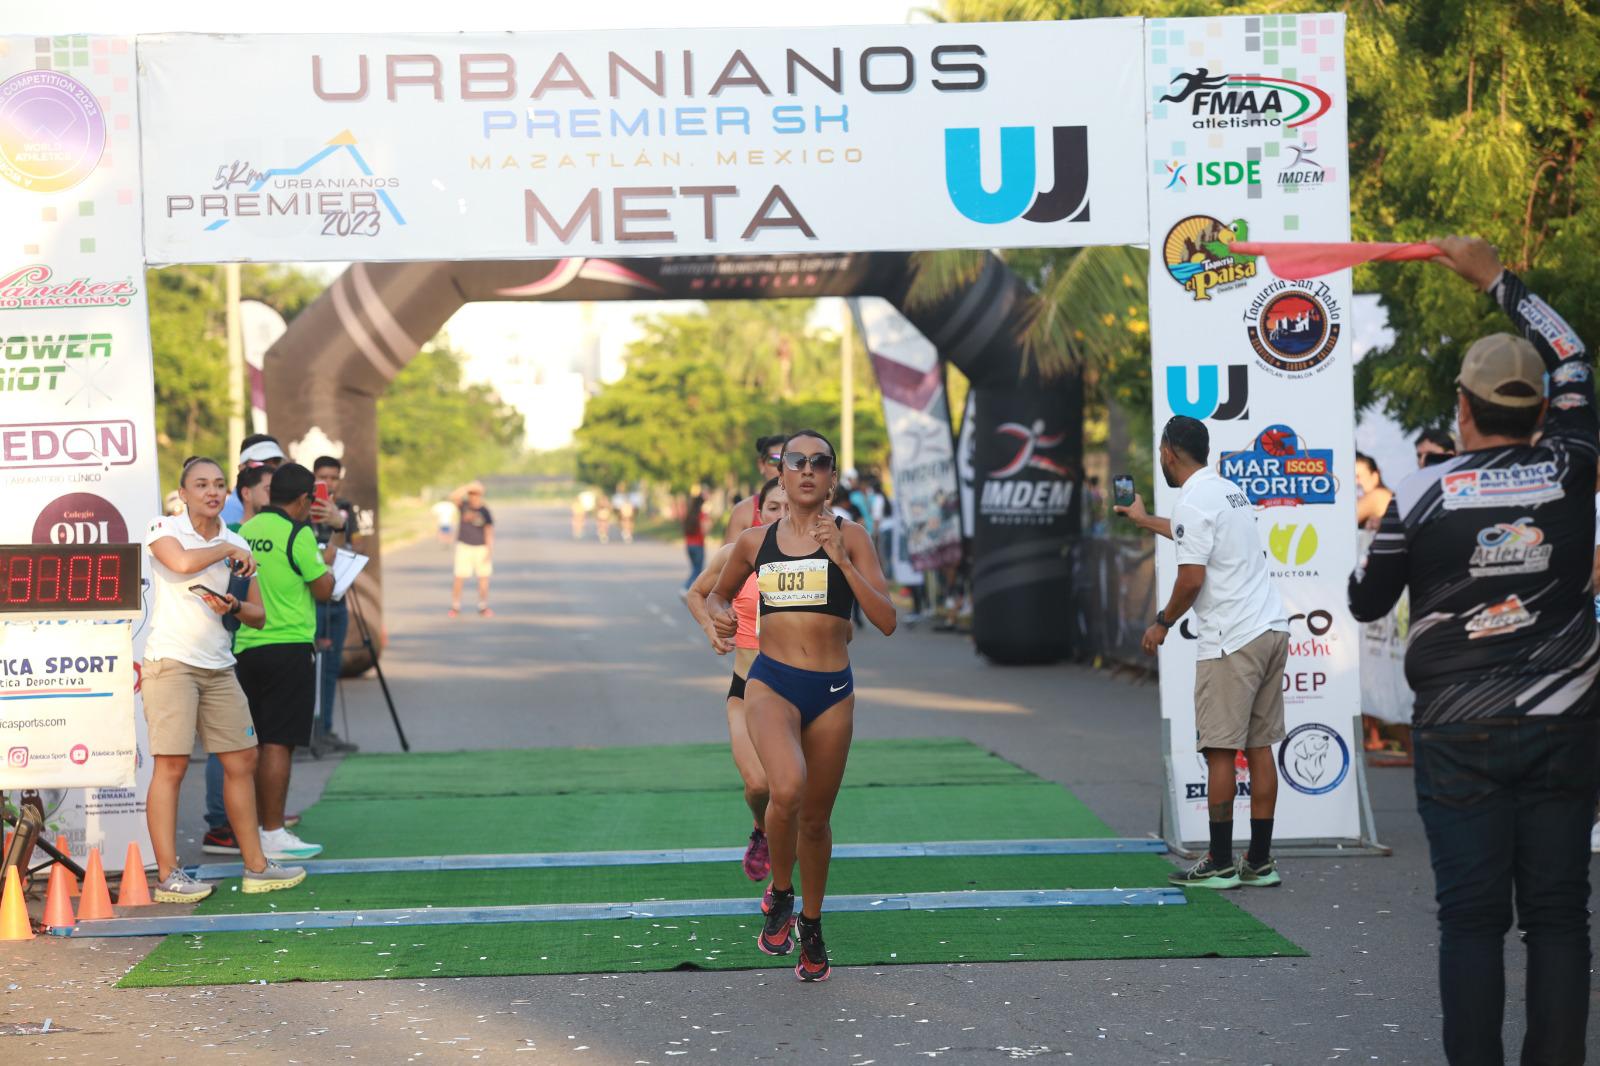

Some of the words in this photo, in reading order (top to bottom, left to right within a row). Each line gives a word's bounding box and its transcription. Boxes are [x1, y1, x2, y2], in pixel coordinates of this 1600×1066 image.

[311, 43, 989, 102] URBANIANOS
[3, 74, 76, 96] COMPETITION
[75, 90, 98, 117] 2023
[1192, 90, 1282, 115] FMAA
[482, 106, 751, 139] PREMIER
[1192, 117, 1281, 129] atletismo
[716, 147, 863, 166] MEXICO
[274, 177, 400, 189] URBANIANOS
[1197, 160, 1261, 186] ISDE
[1277, 171, 1325, 184] IMDEM
[166, 191, 378, 218] PREMIER
[524, 184, 818, 243] META
[320, 209, 381, 237] 2023
[23, 296, 115, 307] REFACCIONES
[1313, 281, 1342, 321] Pablo
[0, 333, 113, 360] OWER
[1224, 458, 1280, 478] MAR
[1287, 460, 1325, 473] ISCOS
[1237, 476, 1330, 495] TORITO
[777, 571, 805, 591] 033
[1270, 569, 1319, 578] RUCTORA
[1289, 638, 1331, 657] ushi
[0, 658, 34, 676] ICA
[45, 655, 118, 674] SPORT
[26, 677, 85, 687] Deportiva
